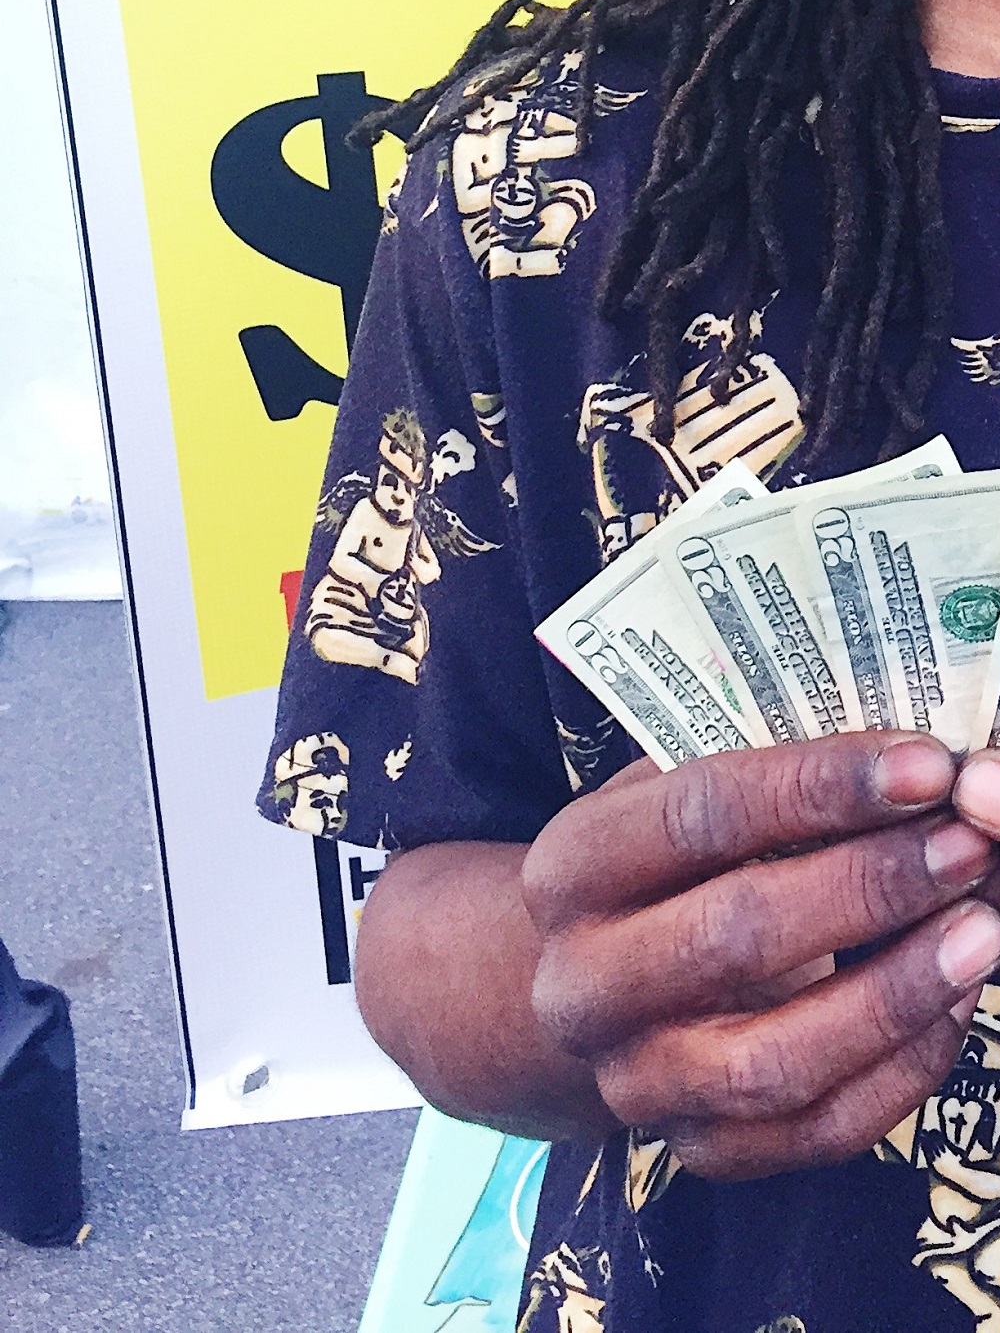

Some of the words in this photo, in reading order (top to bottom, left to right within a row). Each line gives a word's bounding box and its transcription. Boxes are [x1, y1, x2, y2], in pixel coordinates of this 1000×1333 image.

[672, 530, 733, 603] 20
[808, 502, 859, 569] 20
[734, 551, 799, 655] STATES
[868, 528, 908, 629] STATES
[892, 540, 937, 670] AMERICA
[560, 613, 630, 688] 20
[728, 629, 761, 679] NOTE
[763, 561, 836, 692] AMERICA
[770, 643, 790, 671] THE
[843, 598, 864, 646] NOTE
[880, 616, 895, 645] THE
[618, 624, 709, 726] STATES
[647, 629, 753, 751] AMERICA
[786, 649, 840, 737] NITED
[892, 626, 932, 734] UNITED
[921, 667, 945, 709] OF
[643, 710, 689, 763] NOTE
[684, 717, 711, 748] THE
